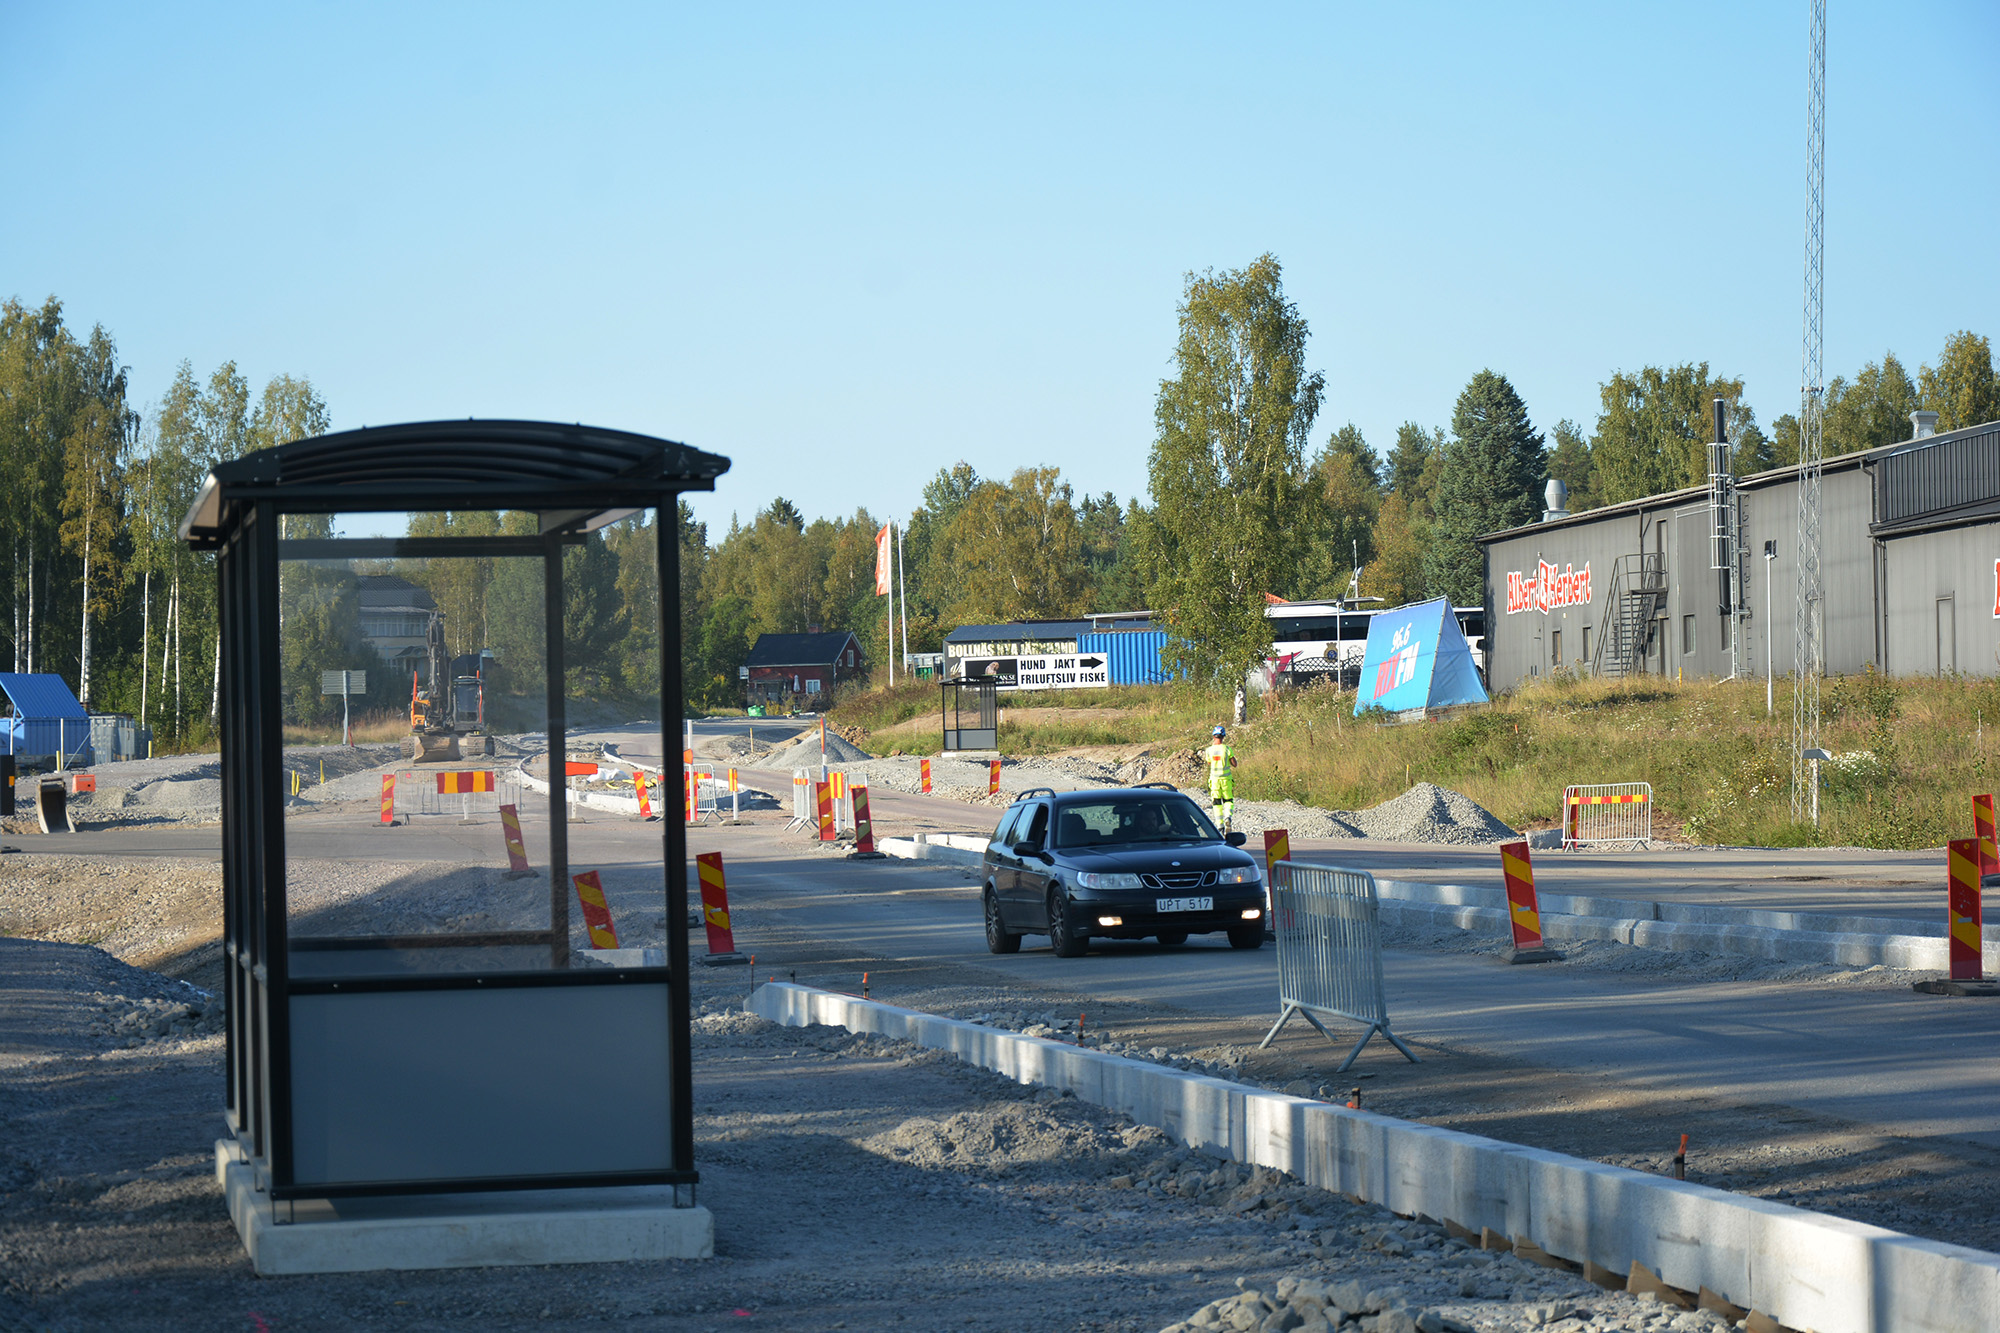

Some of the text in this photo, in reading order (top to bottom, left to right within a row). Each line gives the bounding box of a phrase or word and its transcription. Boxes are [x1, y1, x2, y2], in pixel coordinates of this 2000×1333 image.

[1507, 569, 1539, 614] Albert
[1549, 561, 1592, 608] Herbert
[1390, 622, 1413, 653] 96.6
[947, 641, 1078, 658] BOLLNÄS NYA JÄRHAND
[1020, 658, 1075, 670] HUND JAKT
[1020, 672, 1076, 684] FRILUFTSLIV
[1080, 672, 1106, 683] FISKE
[1160, 898, 1210, 911] UPT 517
